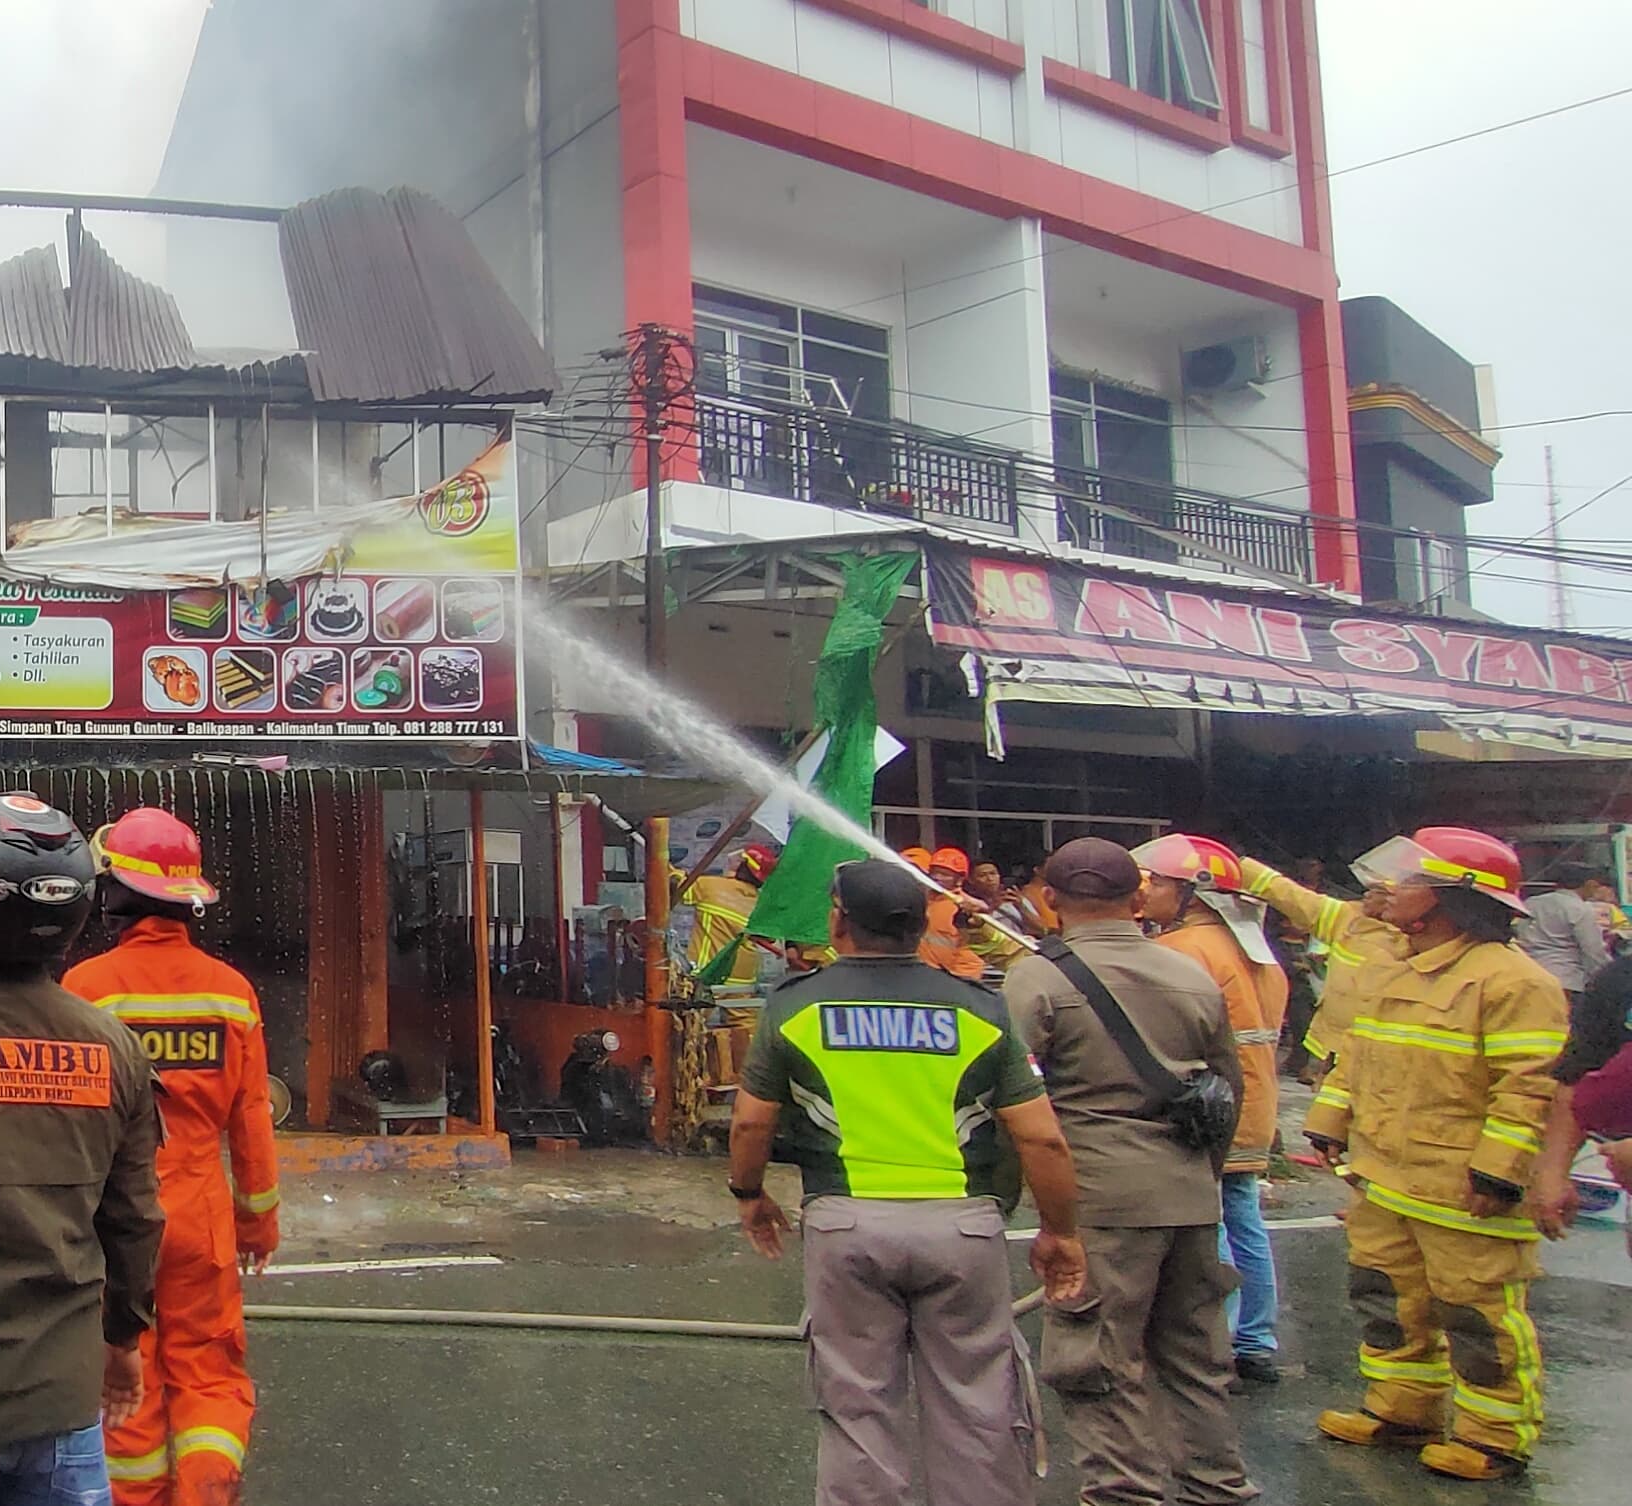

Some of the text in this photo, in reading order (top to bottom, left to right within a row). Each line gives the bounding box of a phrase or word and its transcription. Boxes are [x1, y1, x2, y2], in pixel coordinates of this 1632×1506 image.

[983, 568, 1050, 620] AS
[1074, 578, 1312, 662] ANI
[23, 634, 105, 649] Tasyakuran
[23, 651, 80, 665] Tahlilan
[23, 668, 46, 682] Dll.
[0, 720, 51, 735] Simpang
[55, 721, 81, 735] Tiga
[85, 721, 130, 735] Gunung
[134, 721, 174, 734] Guntur
[187, 722, 254, 736] Balikpapan
[267, 722, 333, 734] Kalimantan
[336, 722, 369, 734] Timur
[372, 722, 401, 736] Telp.
[403, 722, 425, 734] 081
[429, 721, 452, 734] 288
[455, 721, 478, 734] 777
[481, 721, 504, 733] 131
[33, 880, 82, 897] Viper
[824, 1007, 957, 1050] LINMAS
[135, 1030, 217, 1061] OLISI
